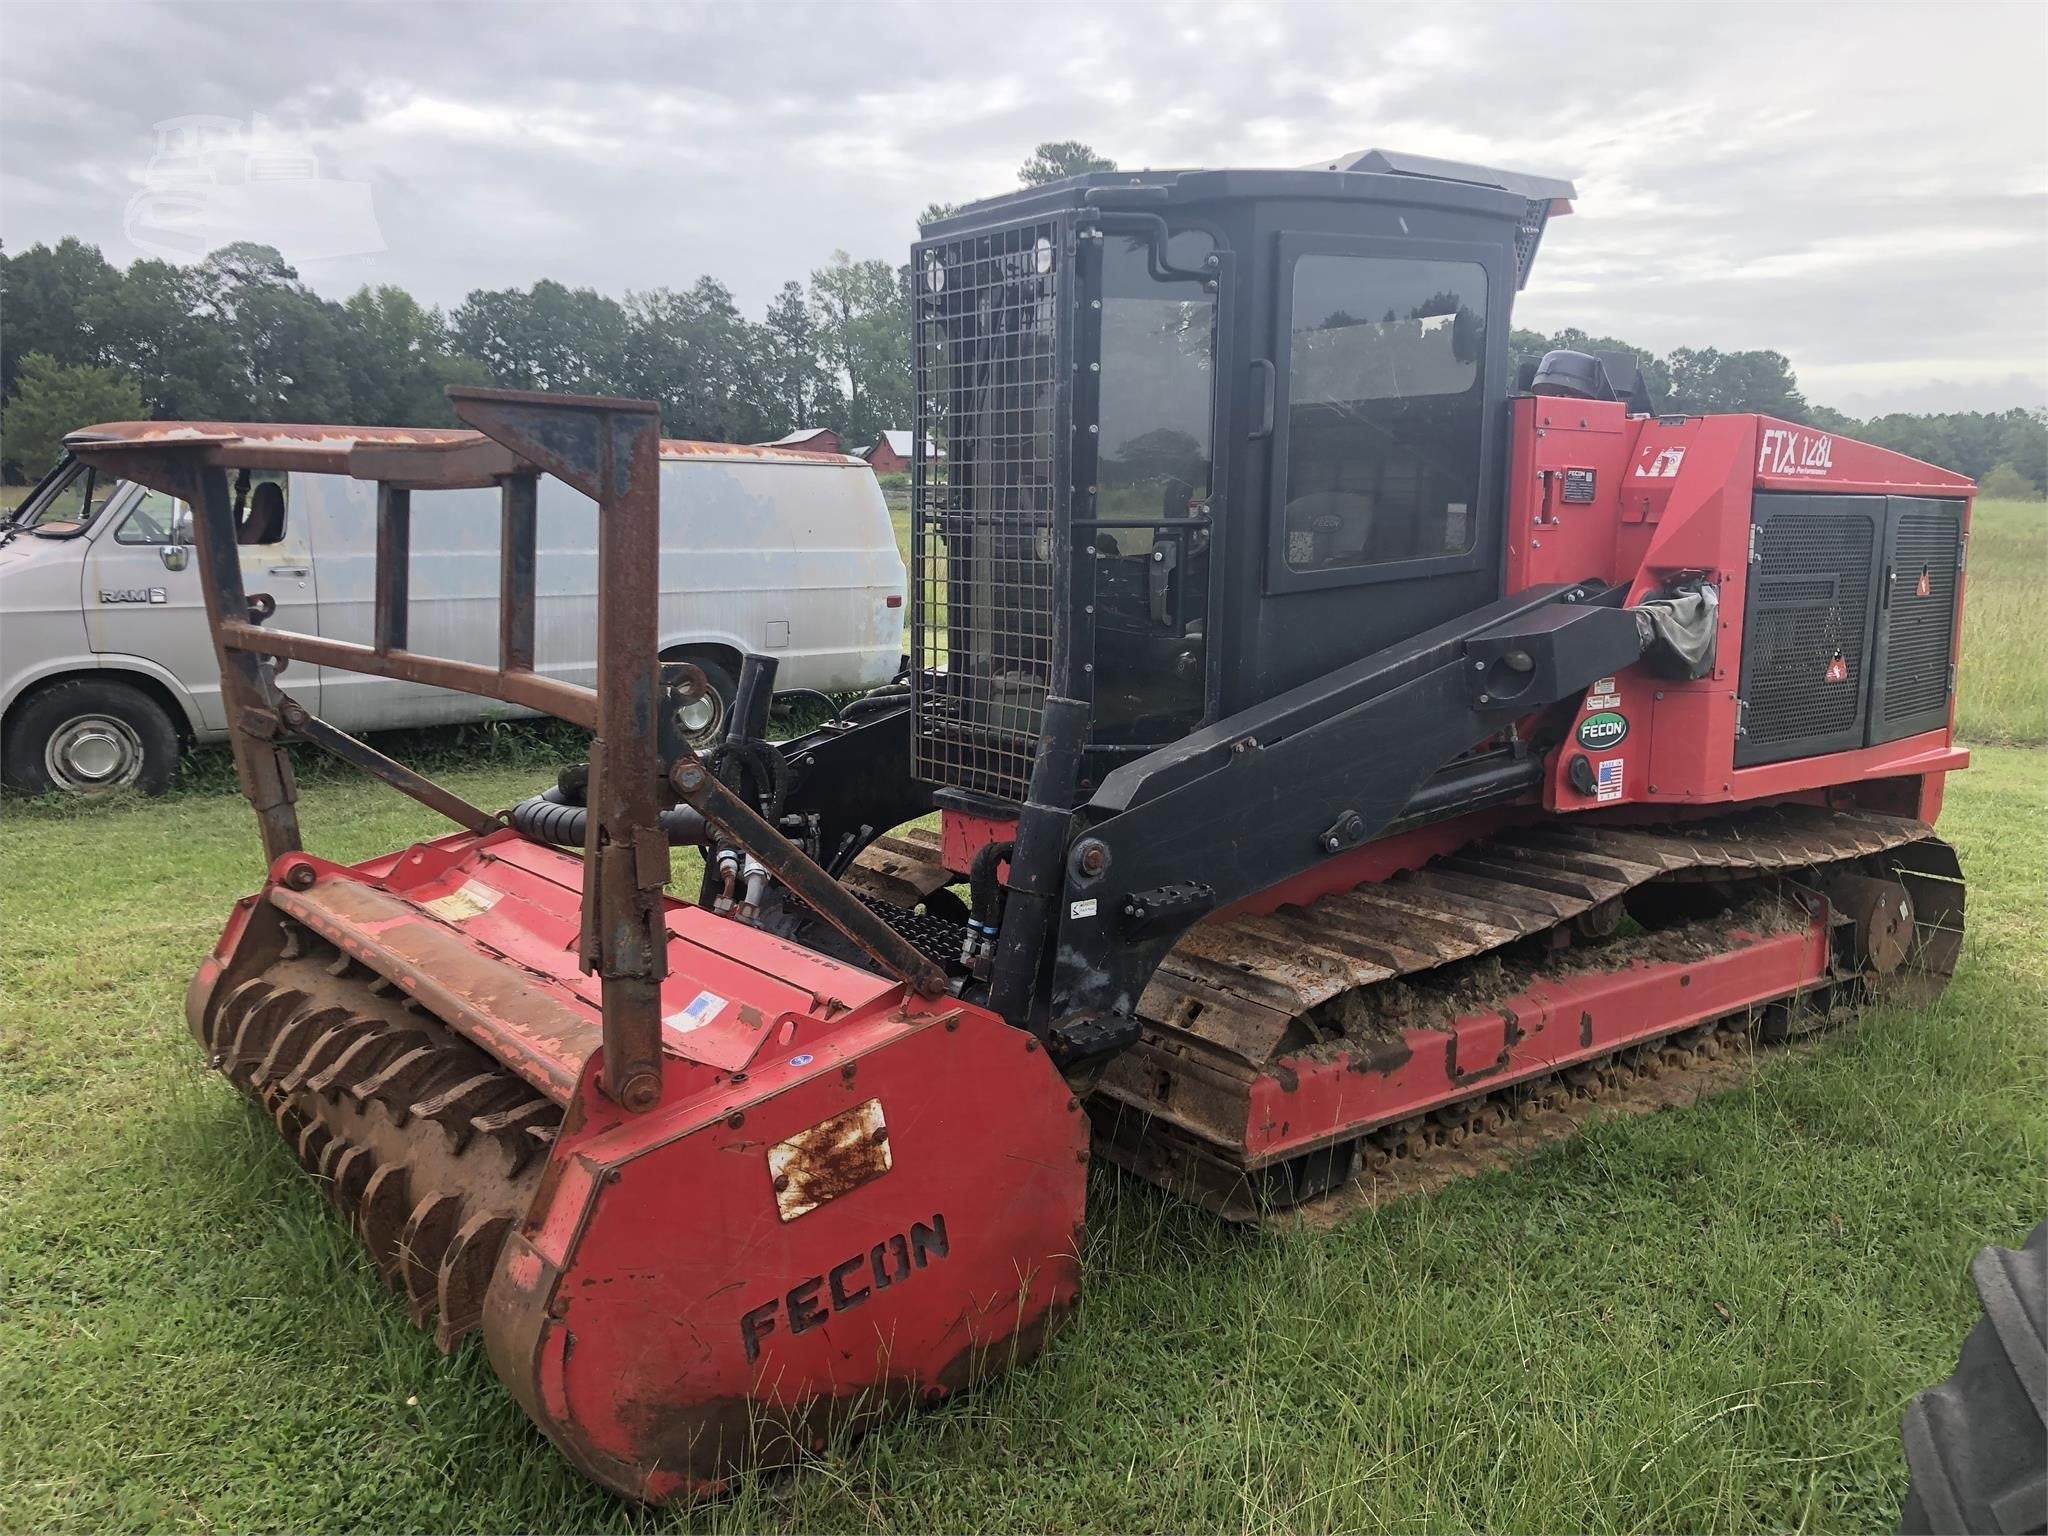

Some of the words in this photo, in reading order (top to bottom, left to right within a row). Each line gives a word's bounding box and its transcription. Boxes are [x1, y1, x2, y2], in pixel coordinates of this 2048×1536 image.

[1758, 429, 1799, 473] FTX
[1801, 435, 1832, 468] 128L
[99, 589, 147, 603] RAM
[1582, 722, 1621, 739] FECON
[741, 1213, 949, 1365] FECON
